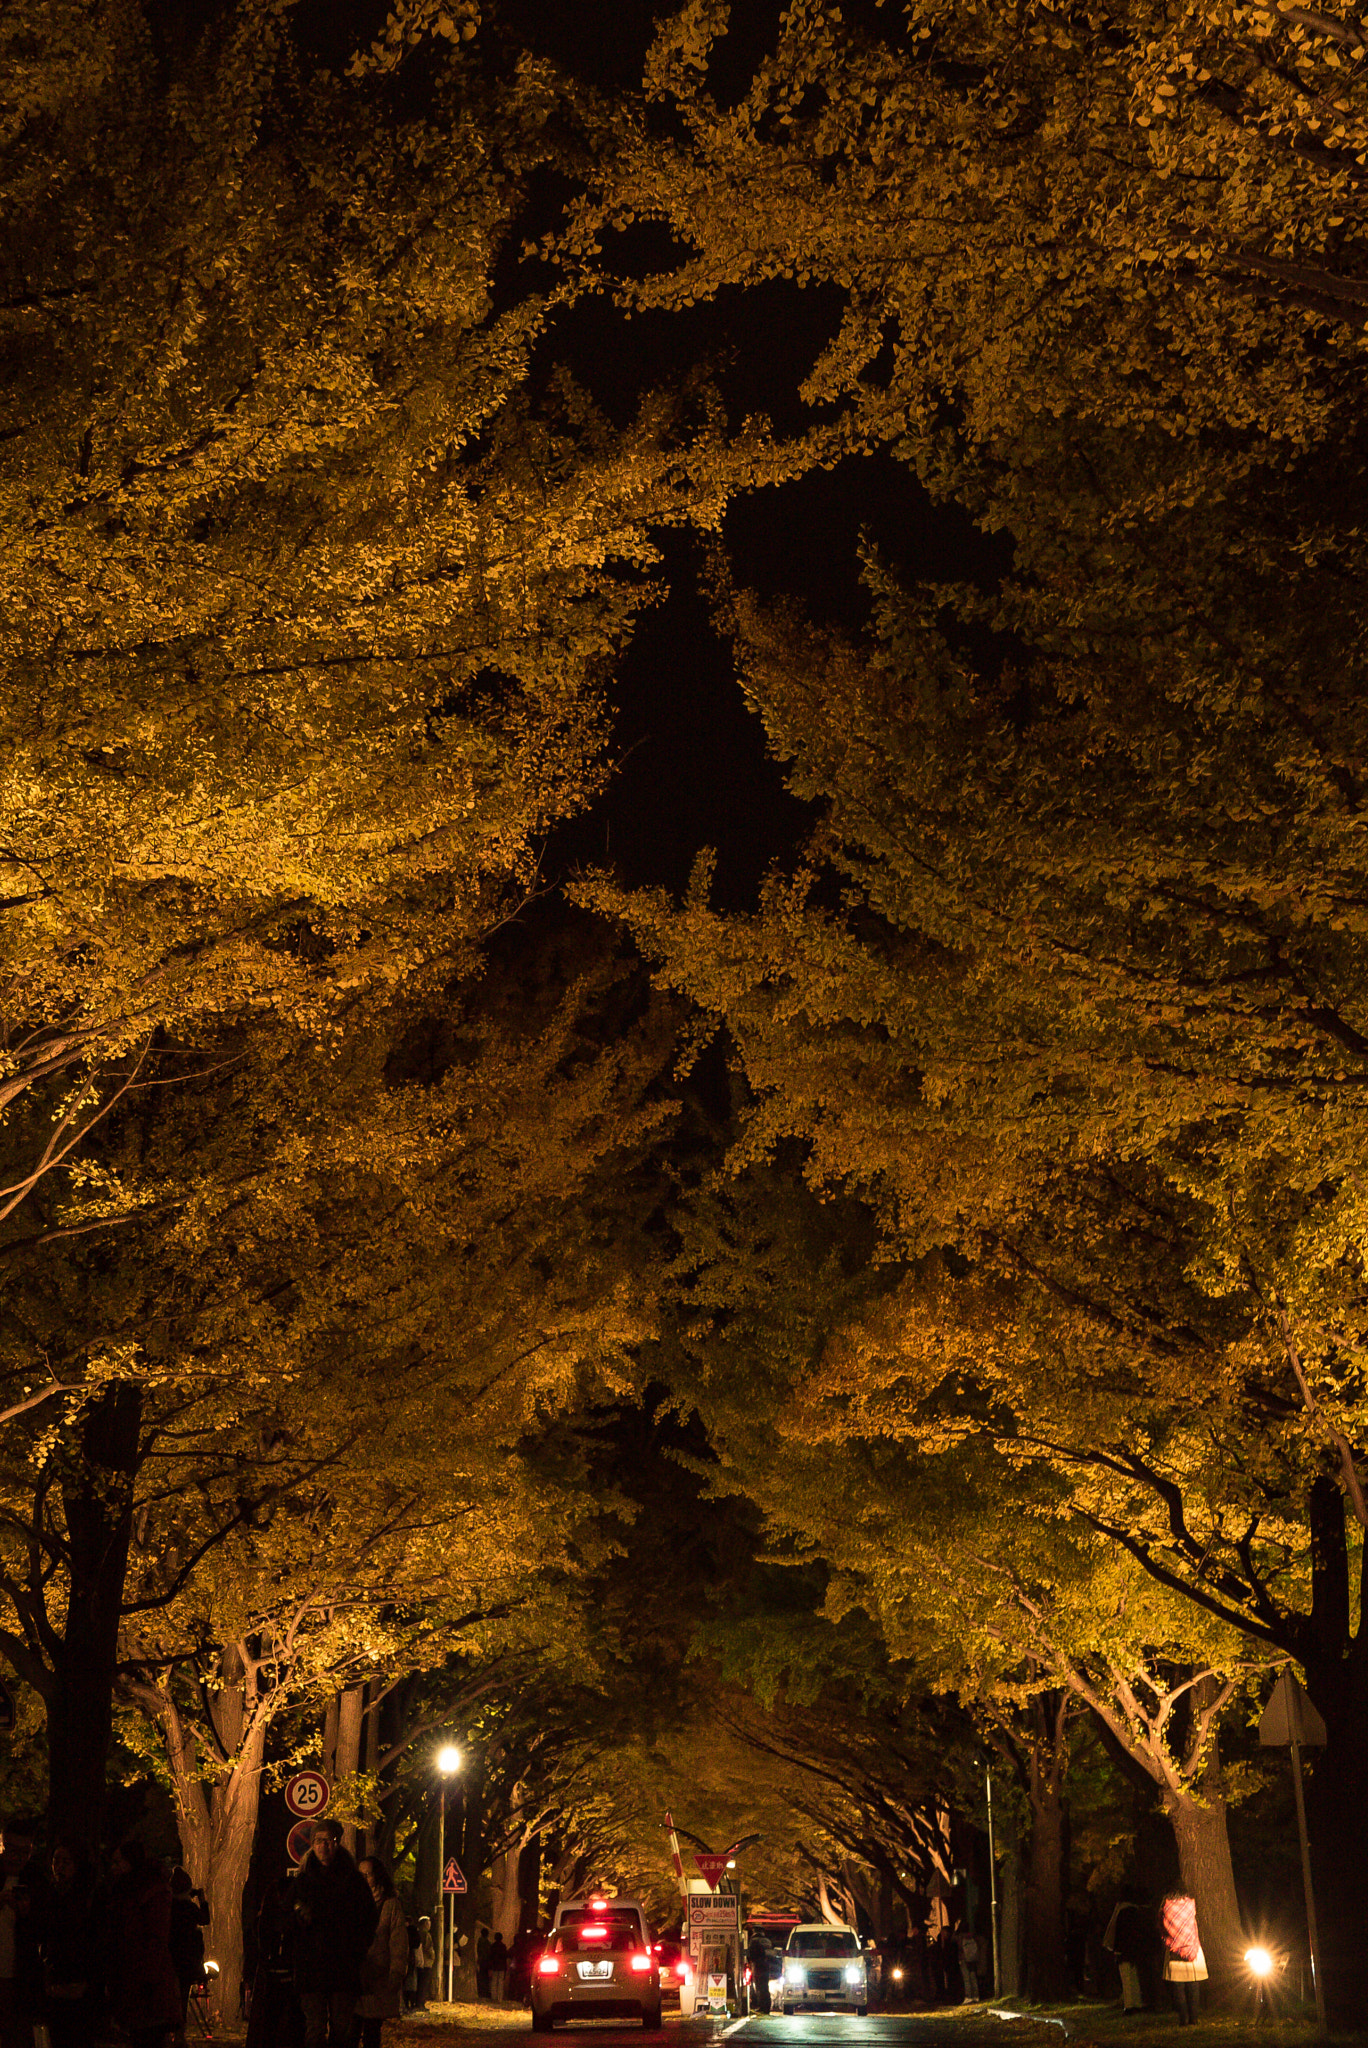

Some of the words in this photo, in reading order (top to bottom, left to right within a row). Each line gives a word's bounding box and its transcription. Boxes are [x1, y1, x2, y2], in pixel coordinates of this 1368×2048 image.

[298, 1784, 318, 1804] 25
[702, 1861, 724, 1869] 止まれ
[691, 1897, 711, 1908] SLOW
[713, 1897, 736, 1908] DOWN
